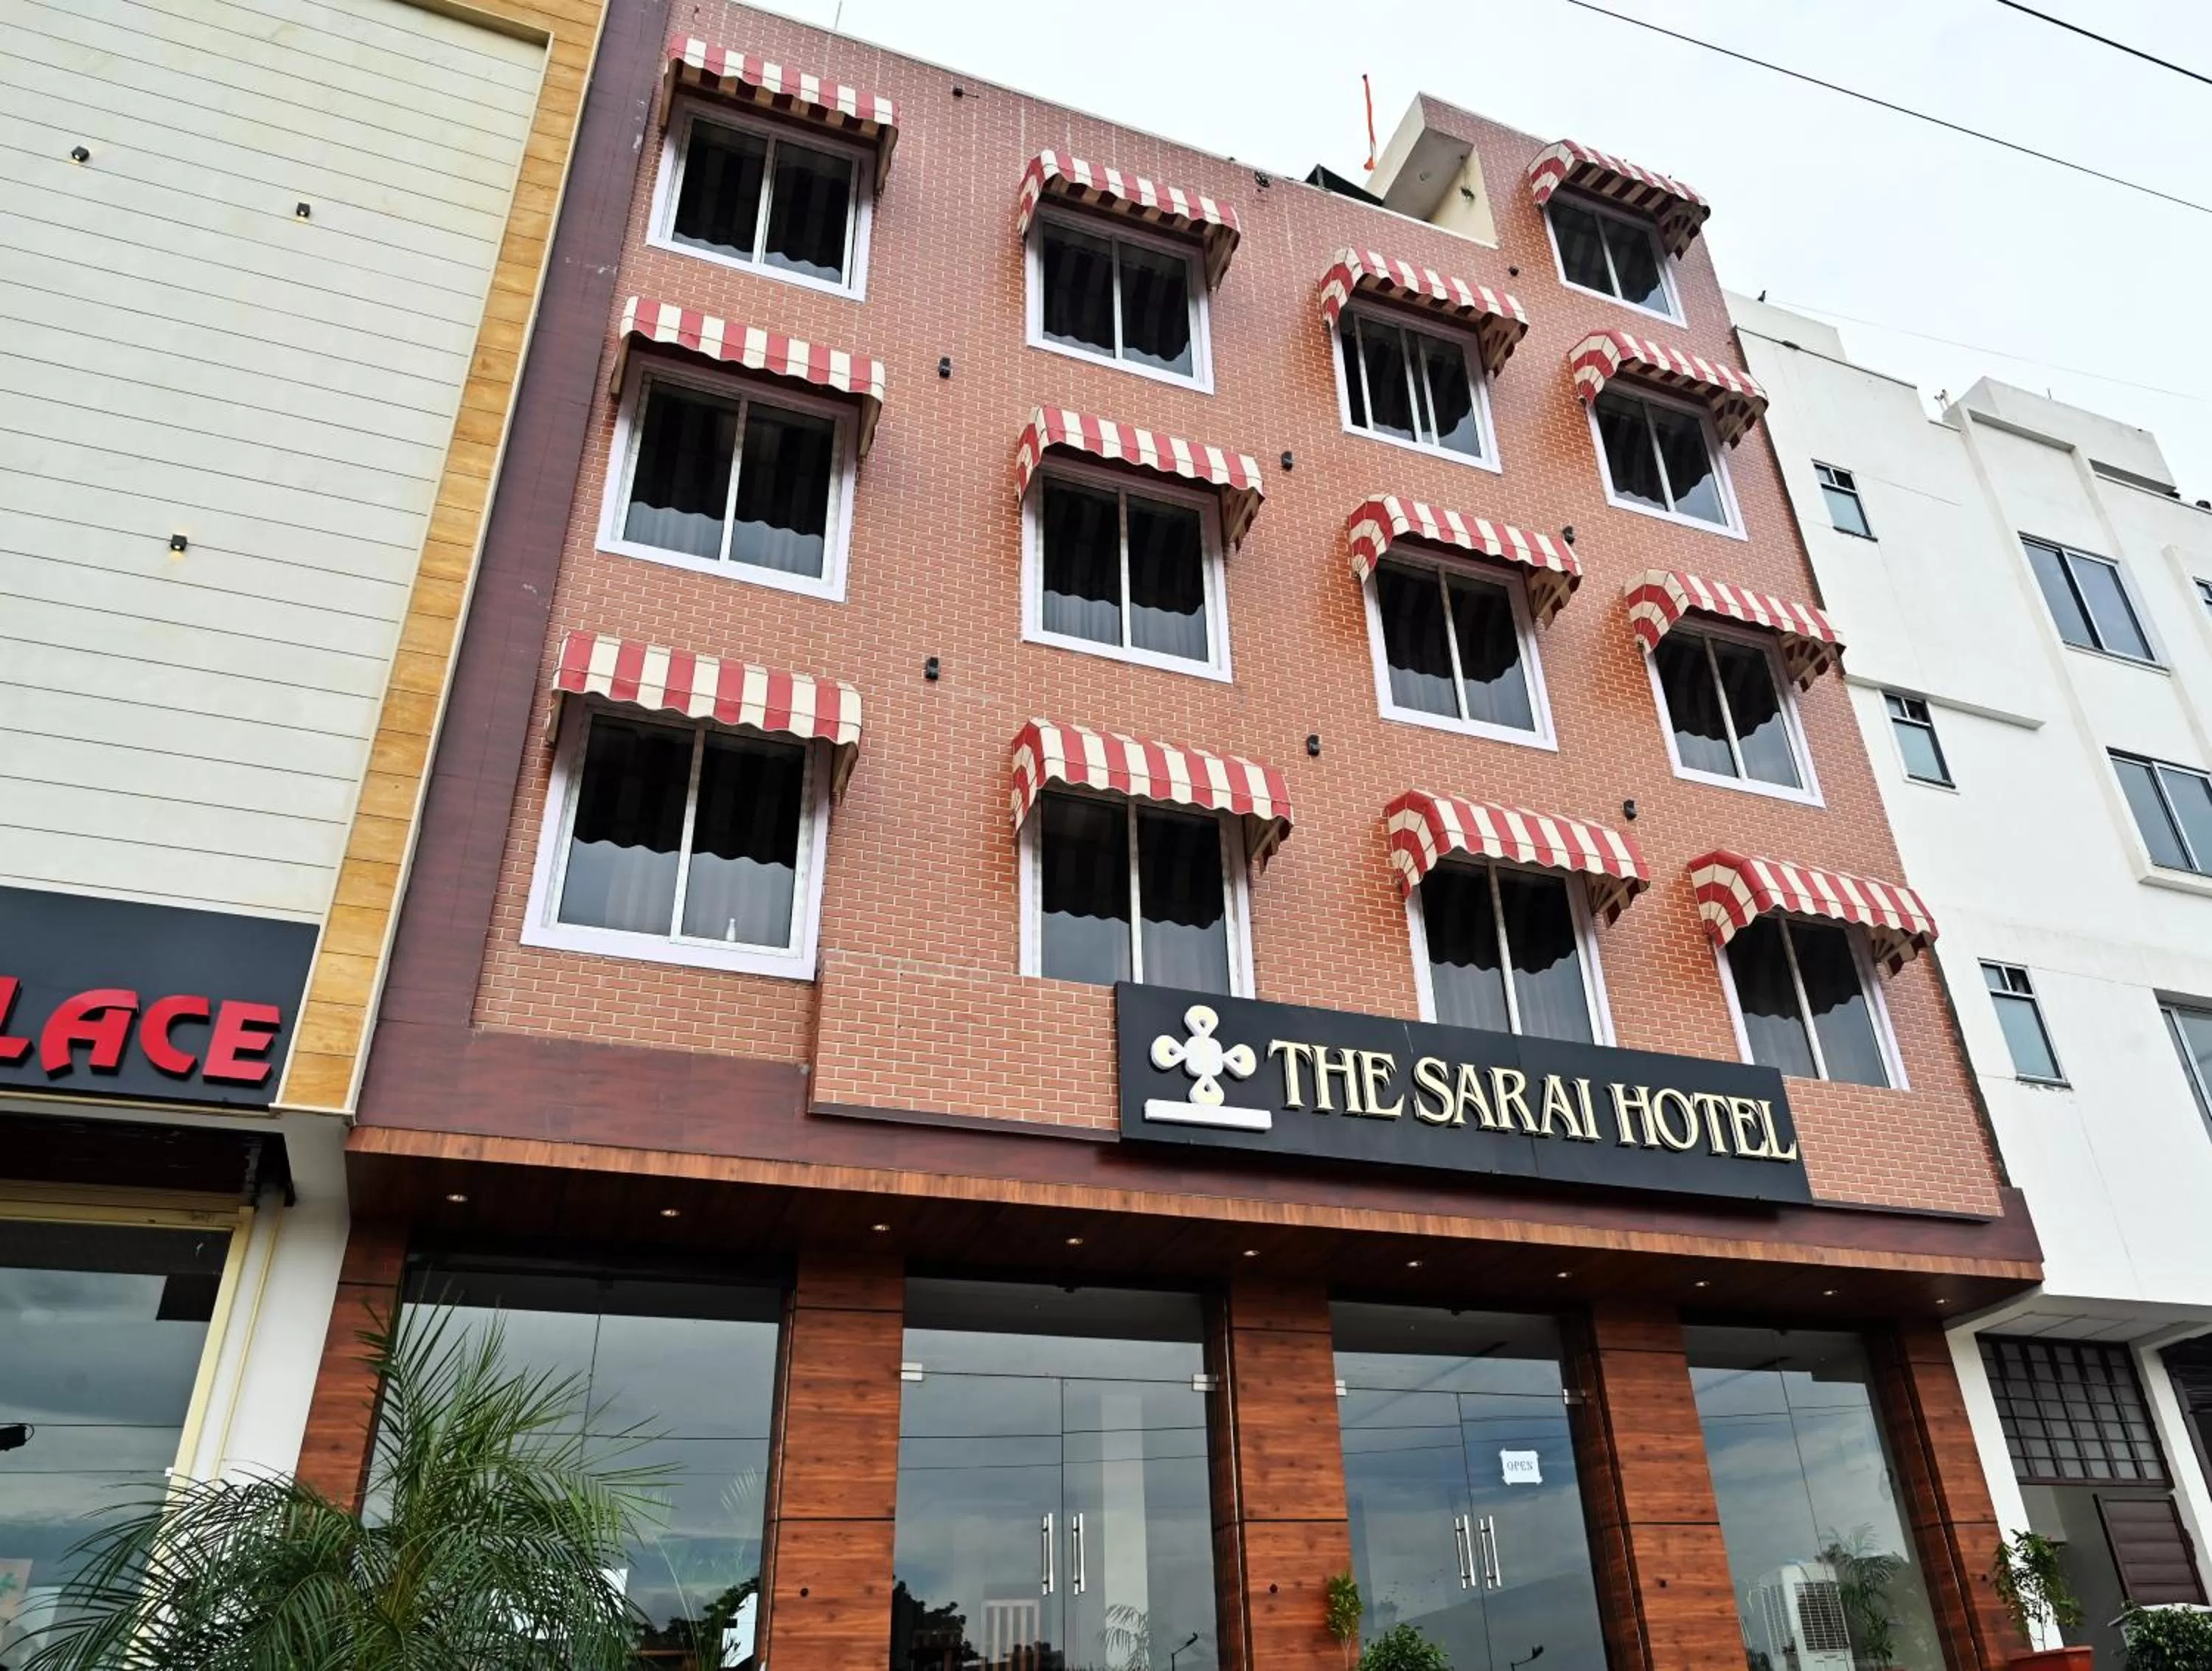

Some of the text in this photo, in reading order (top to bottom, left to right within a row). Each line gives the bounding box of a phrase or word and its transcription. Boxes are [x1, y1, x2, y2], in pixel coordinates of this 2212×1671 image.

[1267, 1039, 1798, 1161] THE SARAI HOTEL
[1506, 1461, 1533, 1472] OPEN
